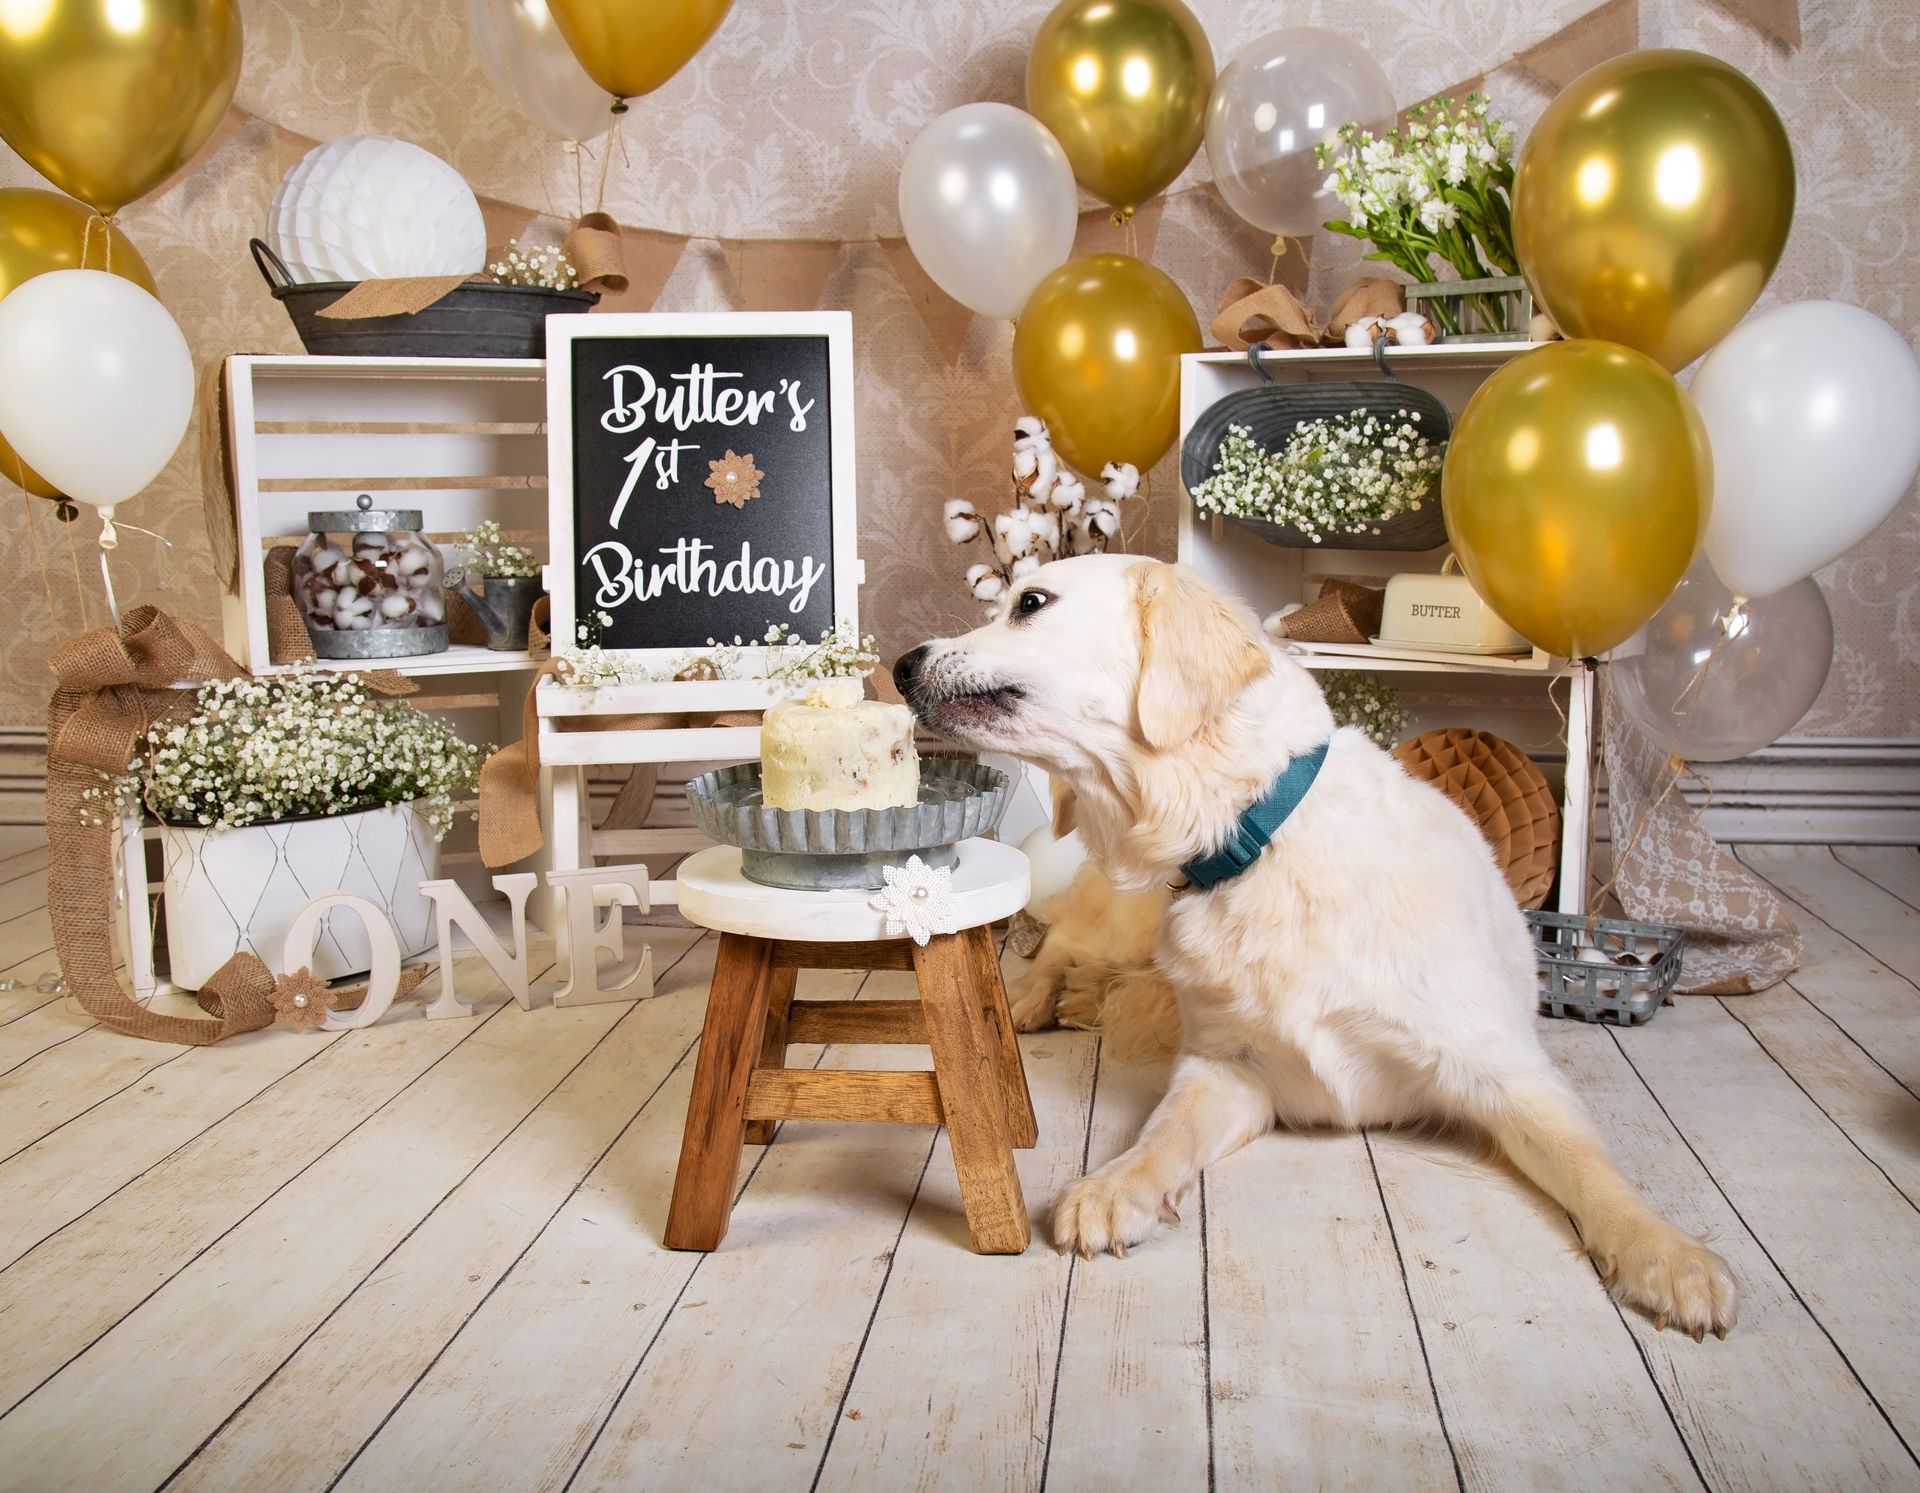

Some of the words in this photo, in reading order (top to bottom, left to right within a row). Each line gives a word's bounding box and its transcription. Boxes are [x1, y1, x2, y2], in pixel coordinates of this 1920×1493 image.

[600, 362, 816, 434] Butter's
[609, 436, 701, 530] 1st
[581, 537, 826, 614] Birthday
[1411, 604, 1461, 619] BUTTER
[282, 863, 655, 1031] ONE
